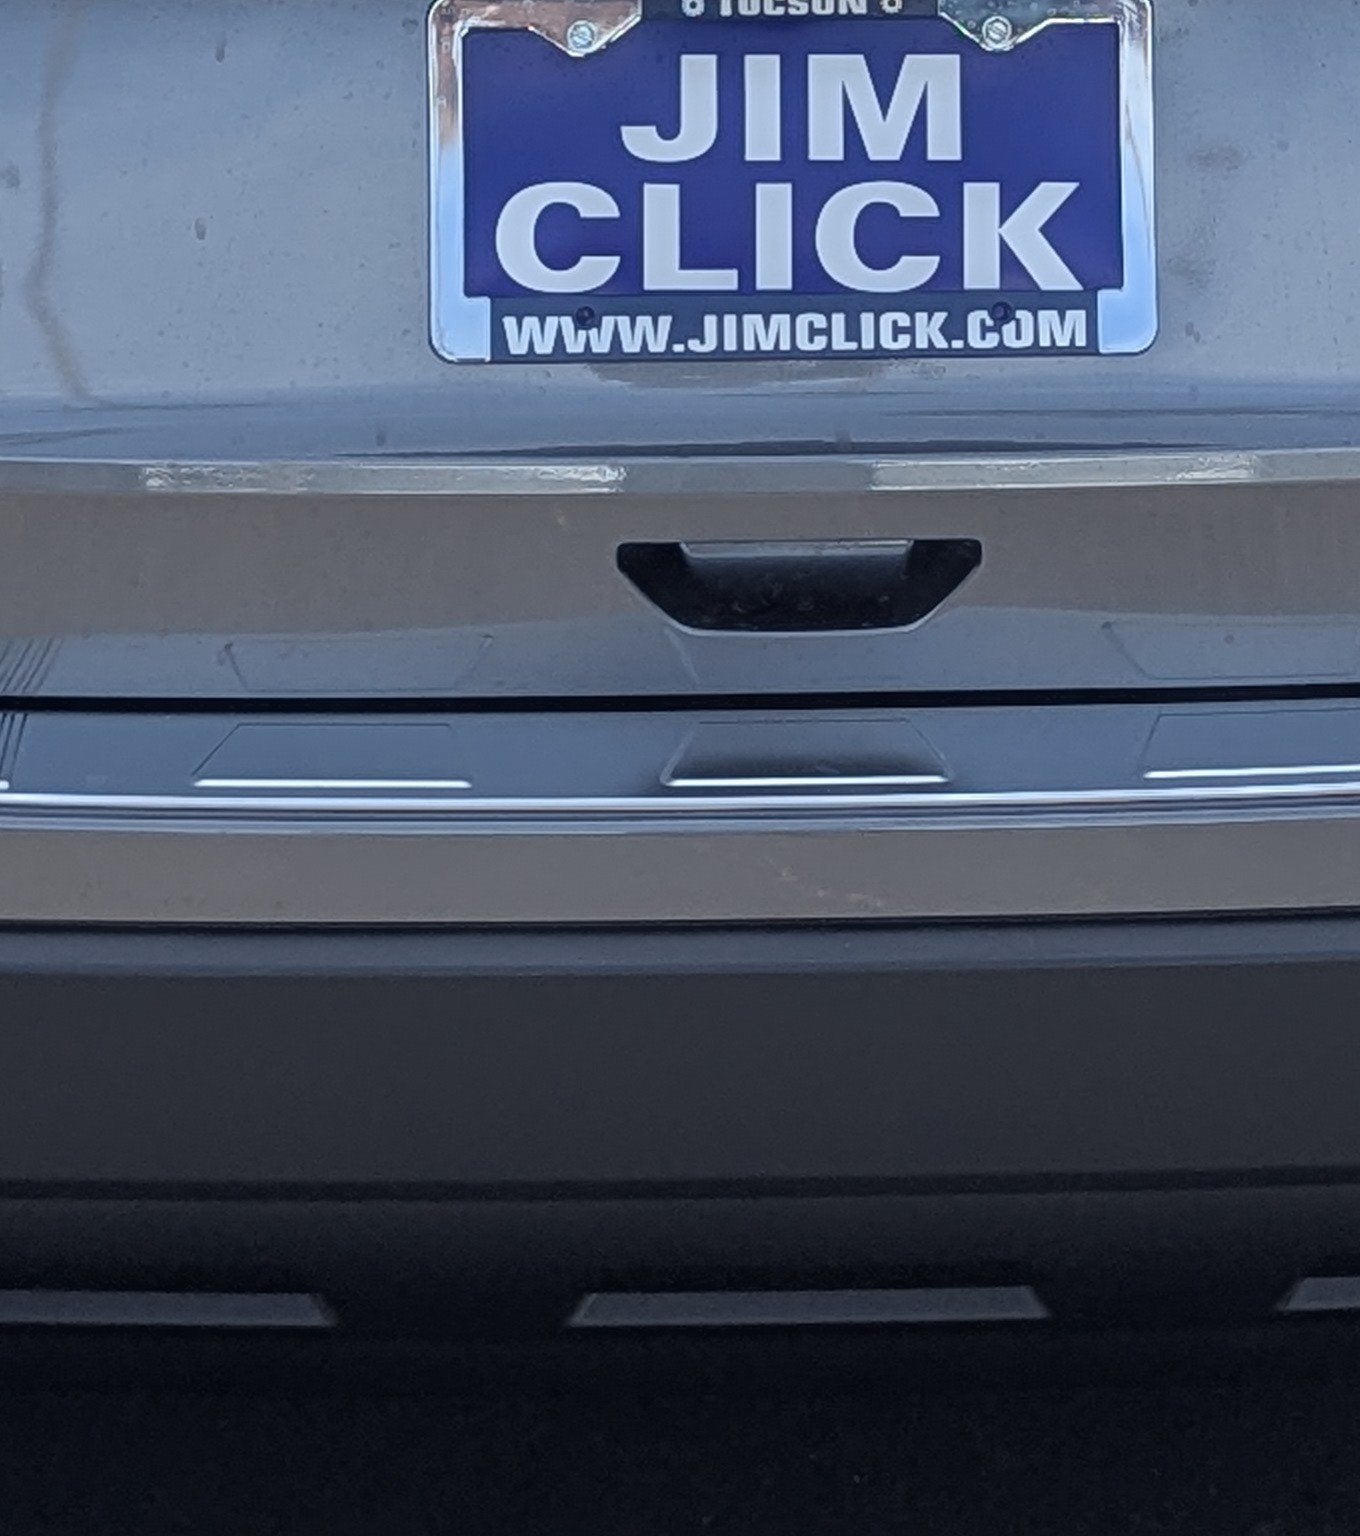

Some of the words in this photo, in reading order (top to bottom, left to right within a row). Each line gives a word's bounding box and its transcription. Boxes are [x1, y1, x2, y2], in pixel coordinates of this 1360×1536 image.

[620, 54, 962, 163] JIM
[495, 181, 1084, 293] CLICK
[503, 309, 1087, 355] WWW.JIMCLICK.COM
